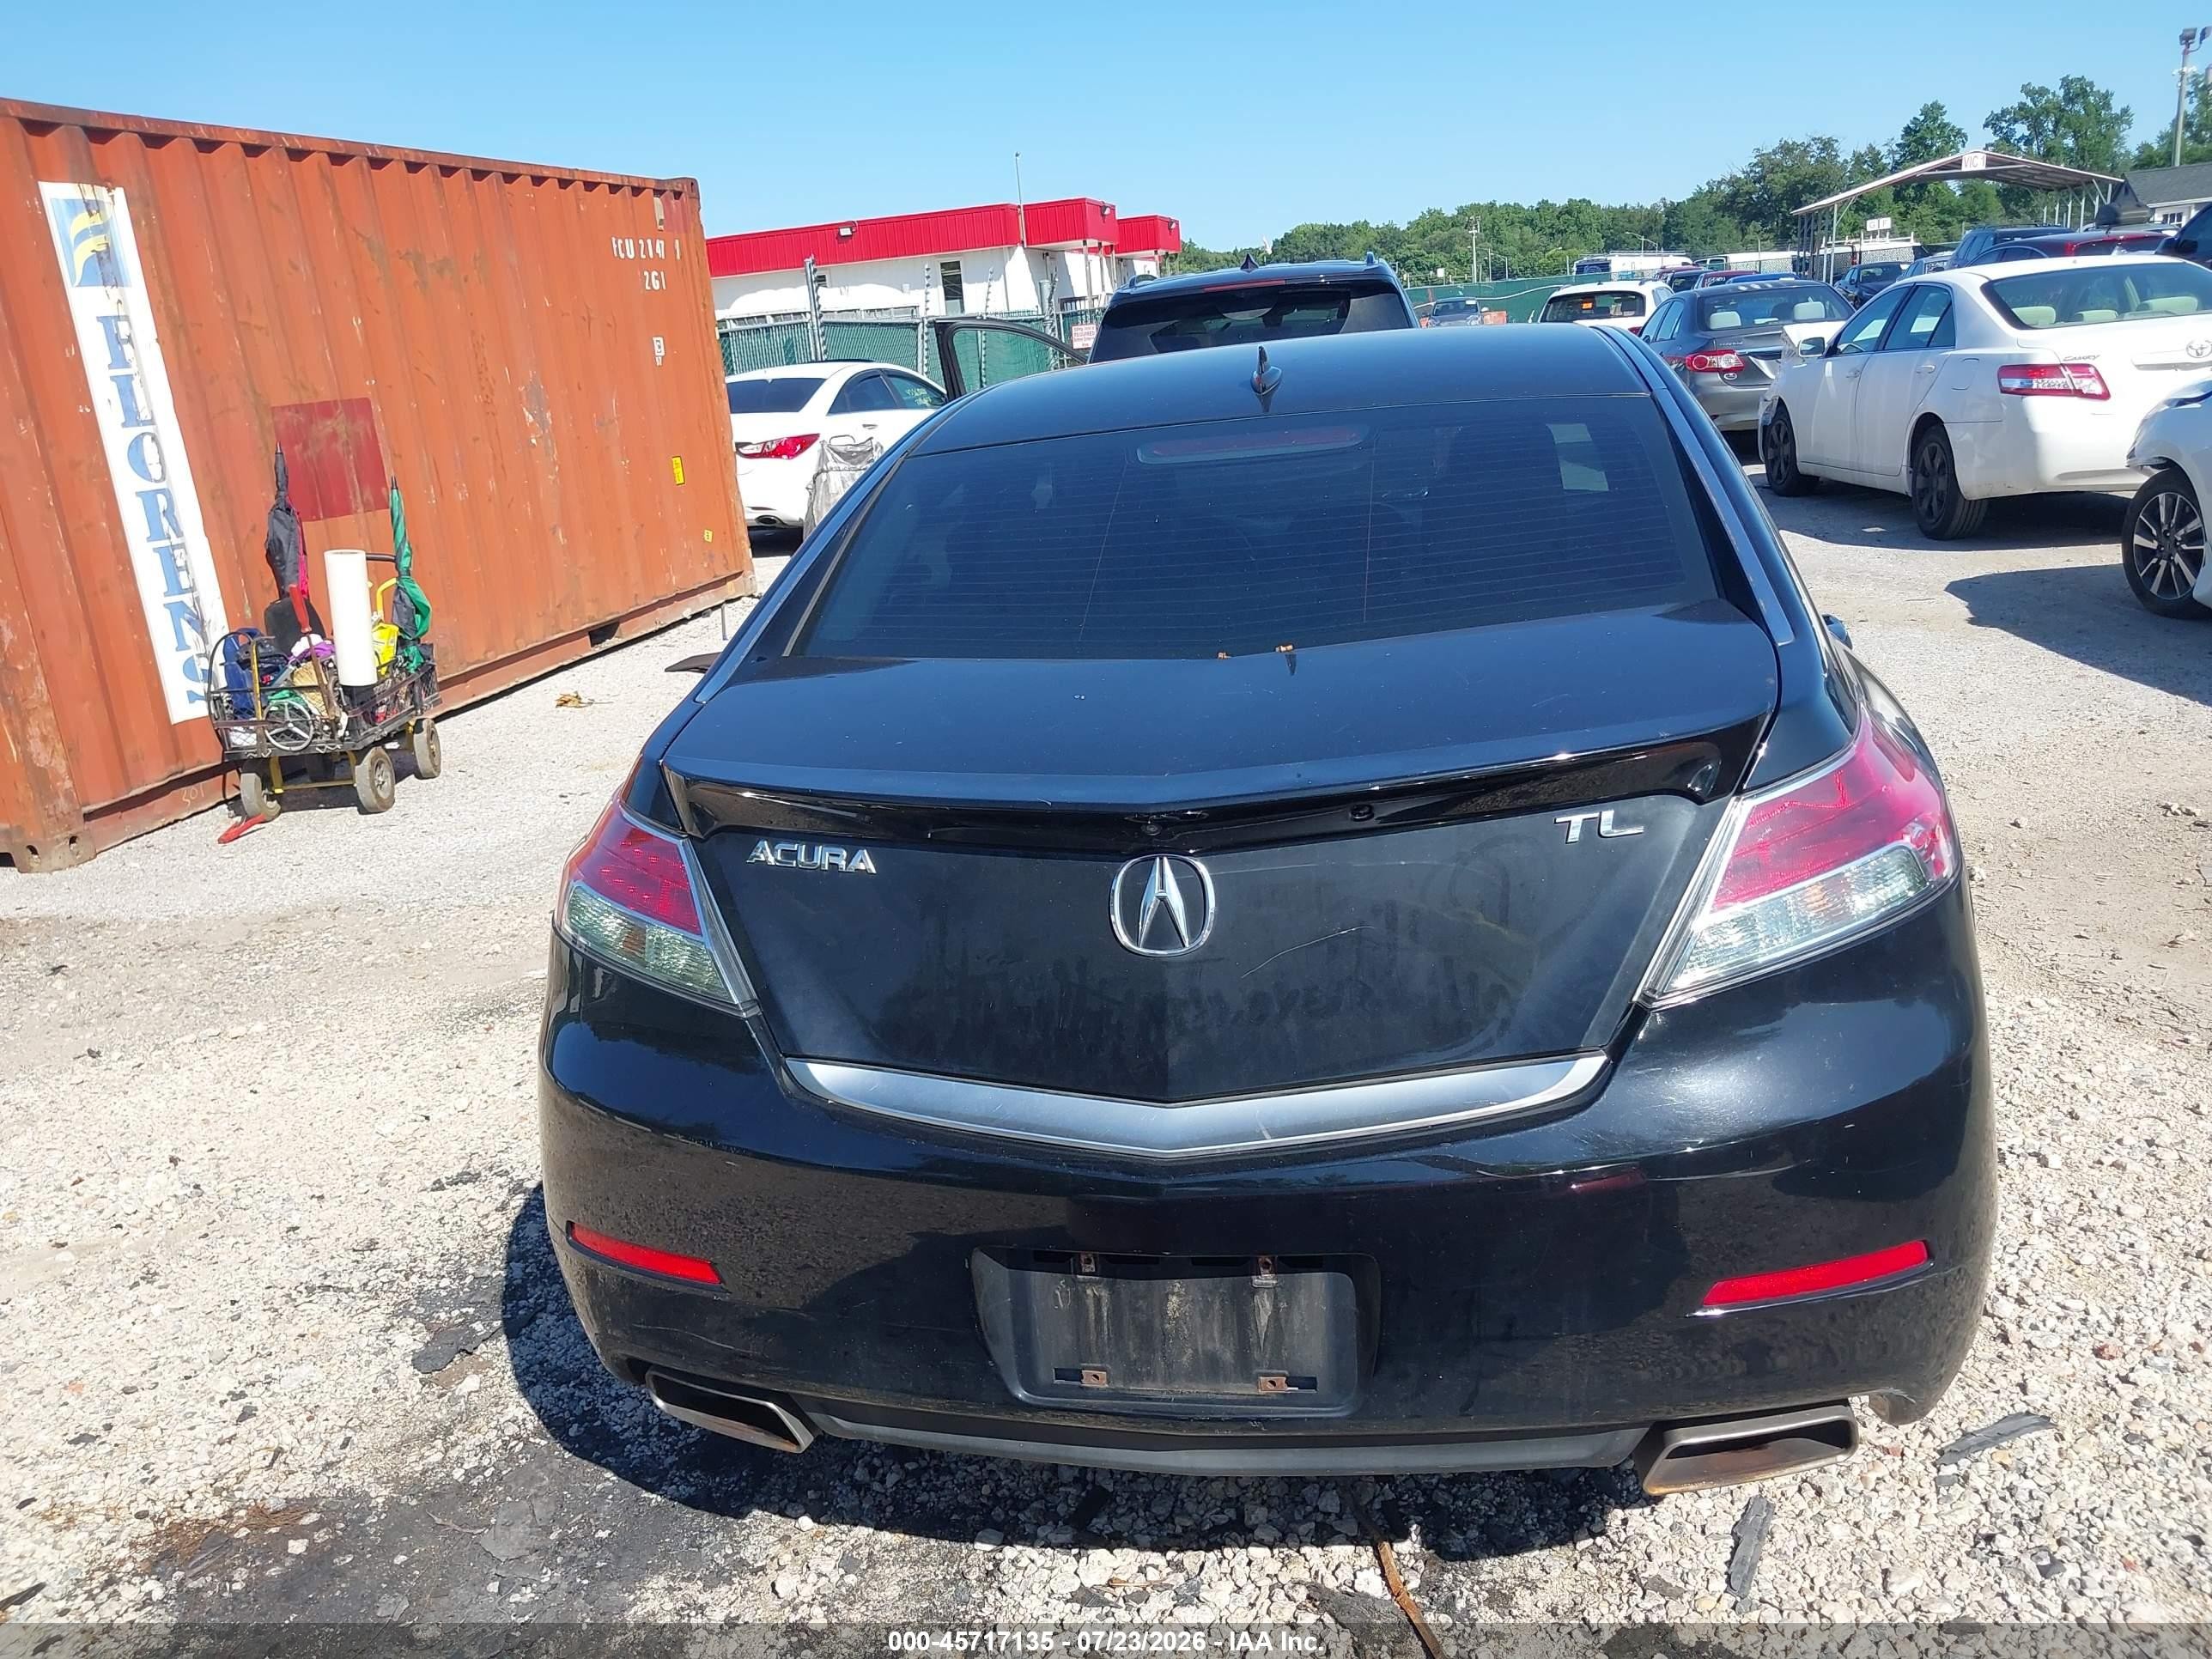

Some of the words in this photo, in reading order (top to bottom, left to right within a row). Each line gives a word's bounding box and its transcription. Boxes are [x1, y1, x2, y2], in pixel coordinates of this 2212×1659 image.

[1964, 156, 1978, 167] VIC
[1553, 809, 1644, 844] TL
[746, 838, 878, 874] ACURA
